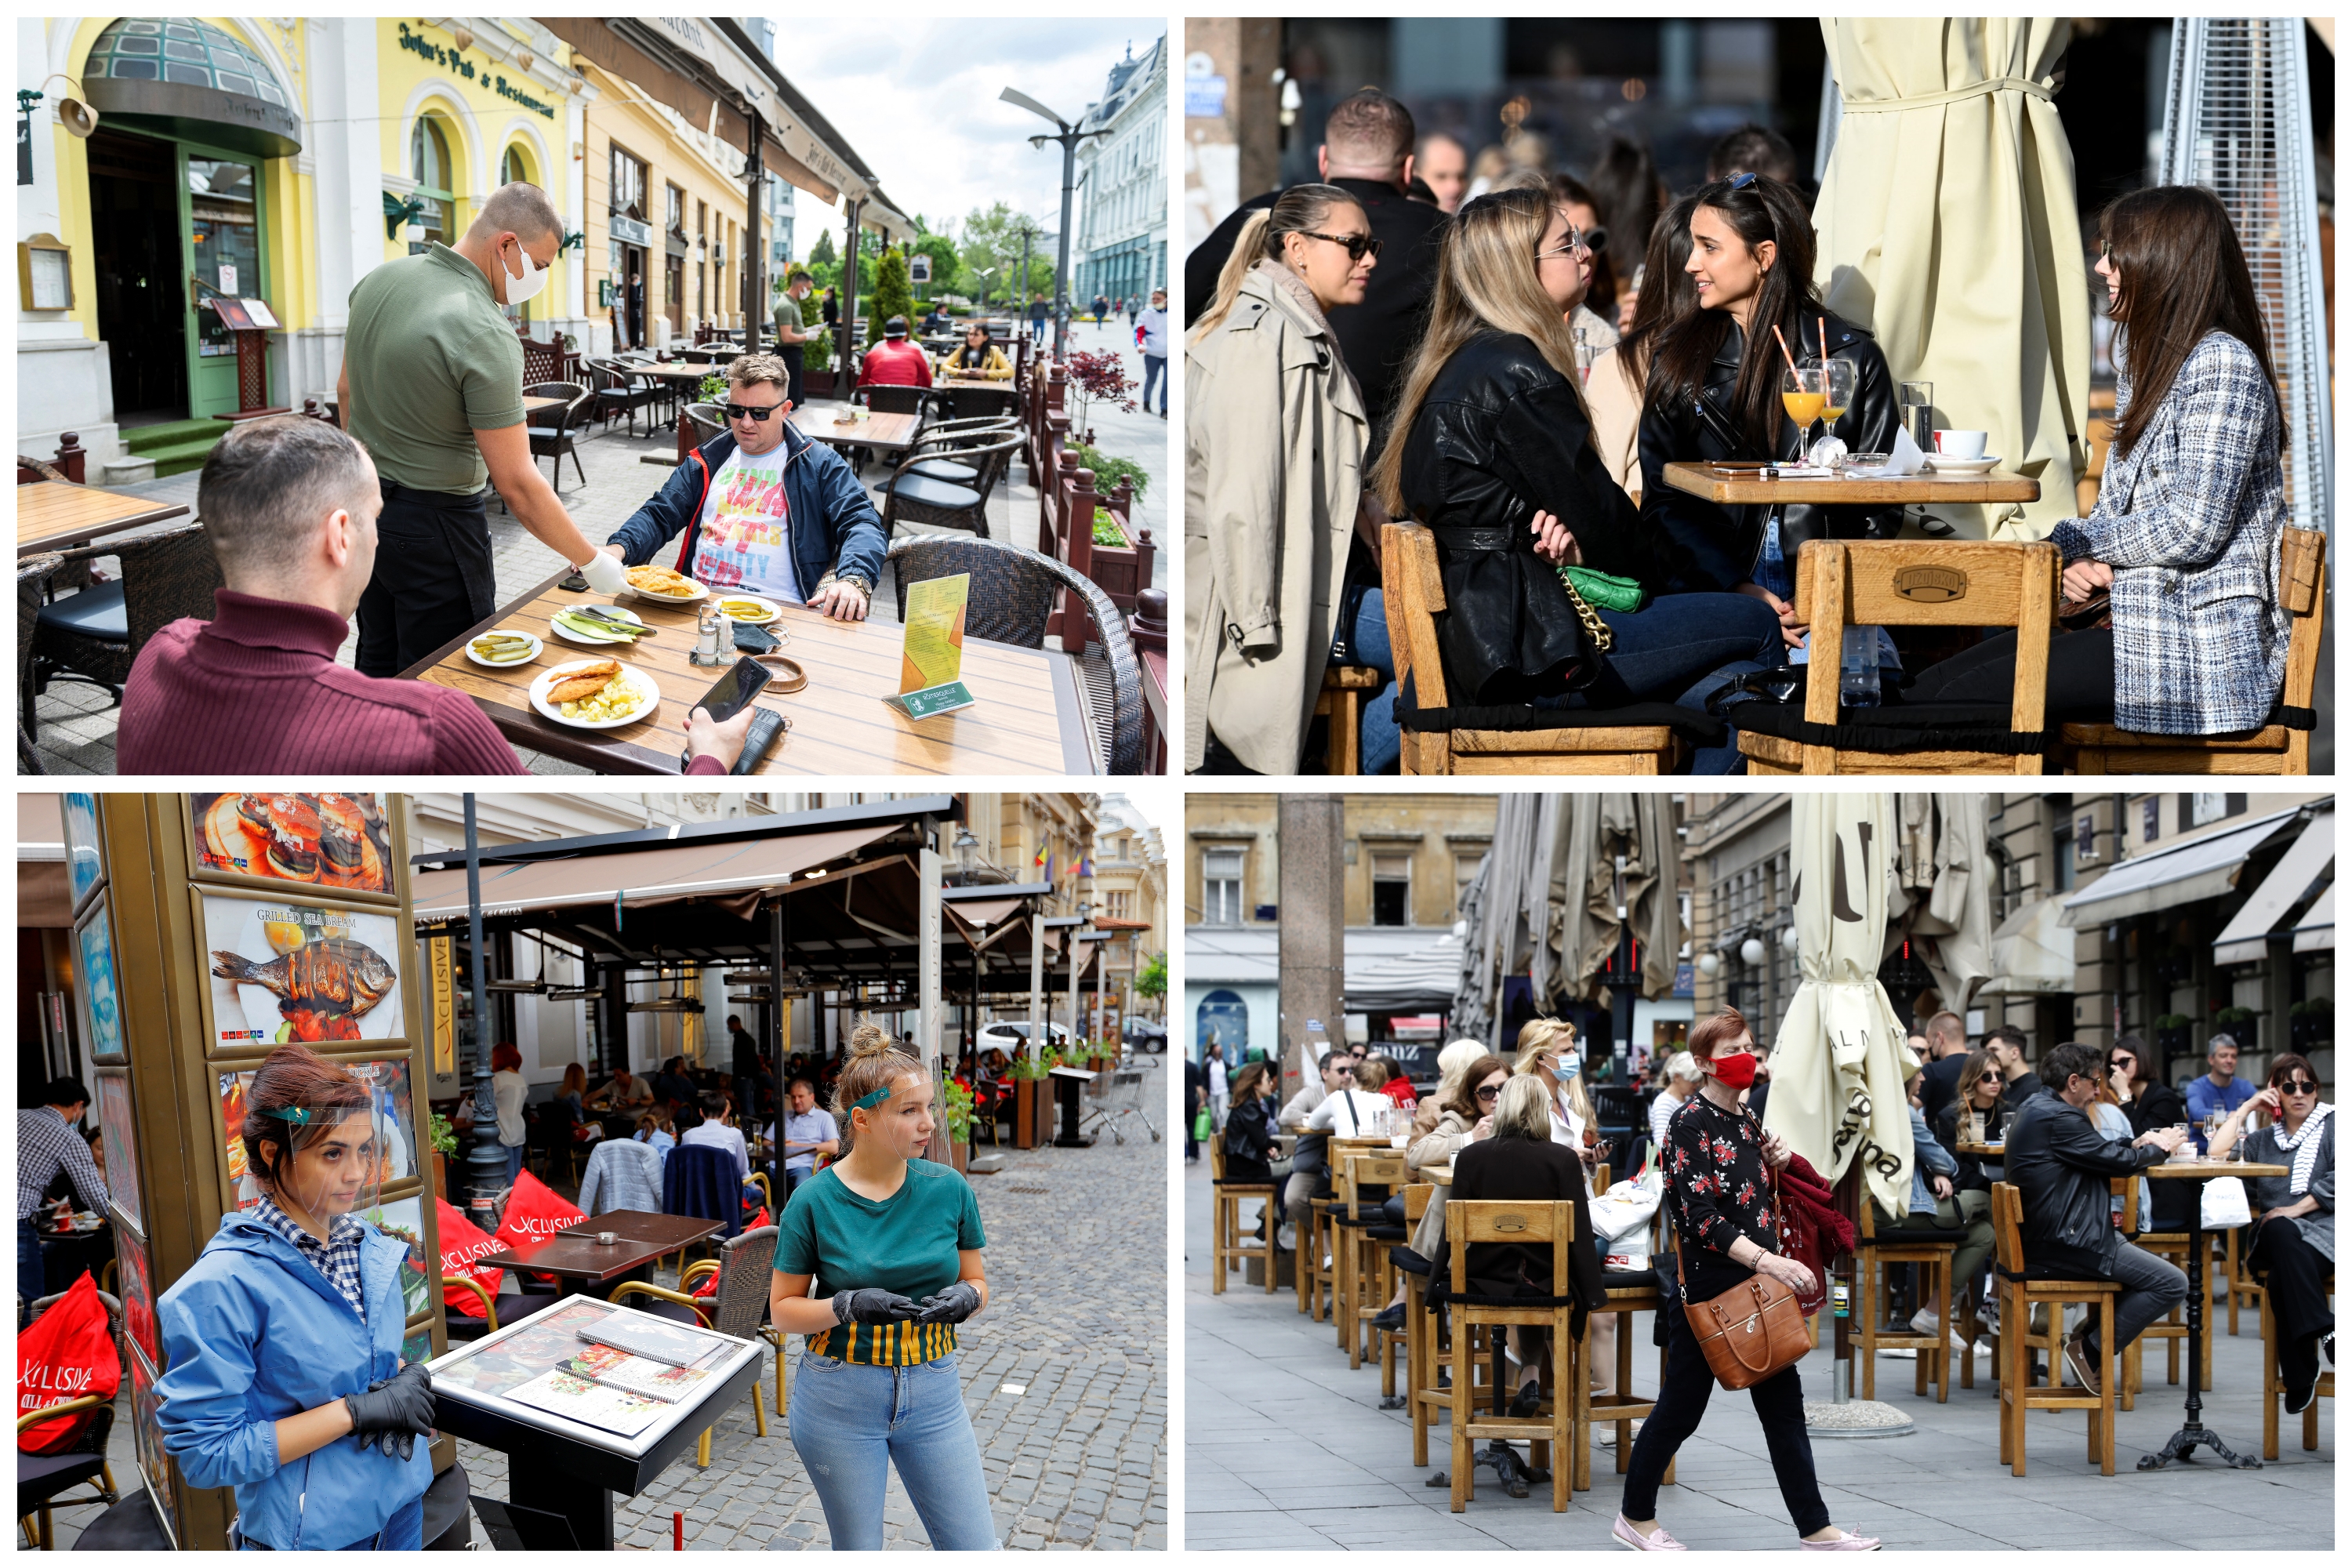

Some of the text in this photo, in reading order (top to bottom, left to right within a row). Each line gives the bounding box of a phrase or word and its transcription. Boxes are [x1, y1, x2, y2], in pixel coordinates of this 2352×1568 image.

[399, 22, 447, 66] John's
[448, 48, 475, 79] Pub
[481, 72, 491, 88] &
[257, 909, 357, 928] GRILLED SEA BREAM
[435, 937, 452, 1055] XCLUSIVE
